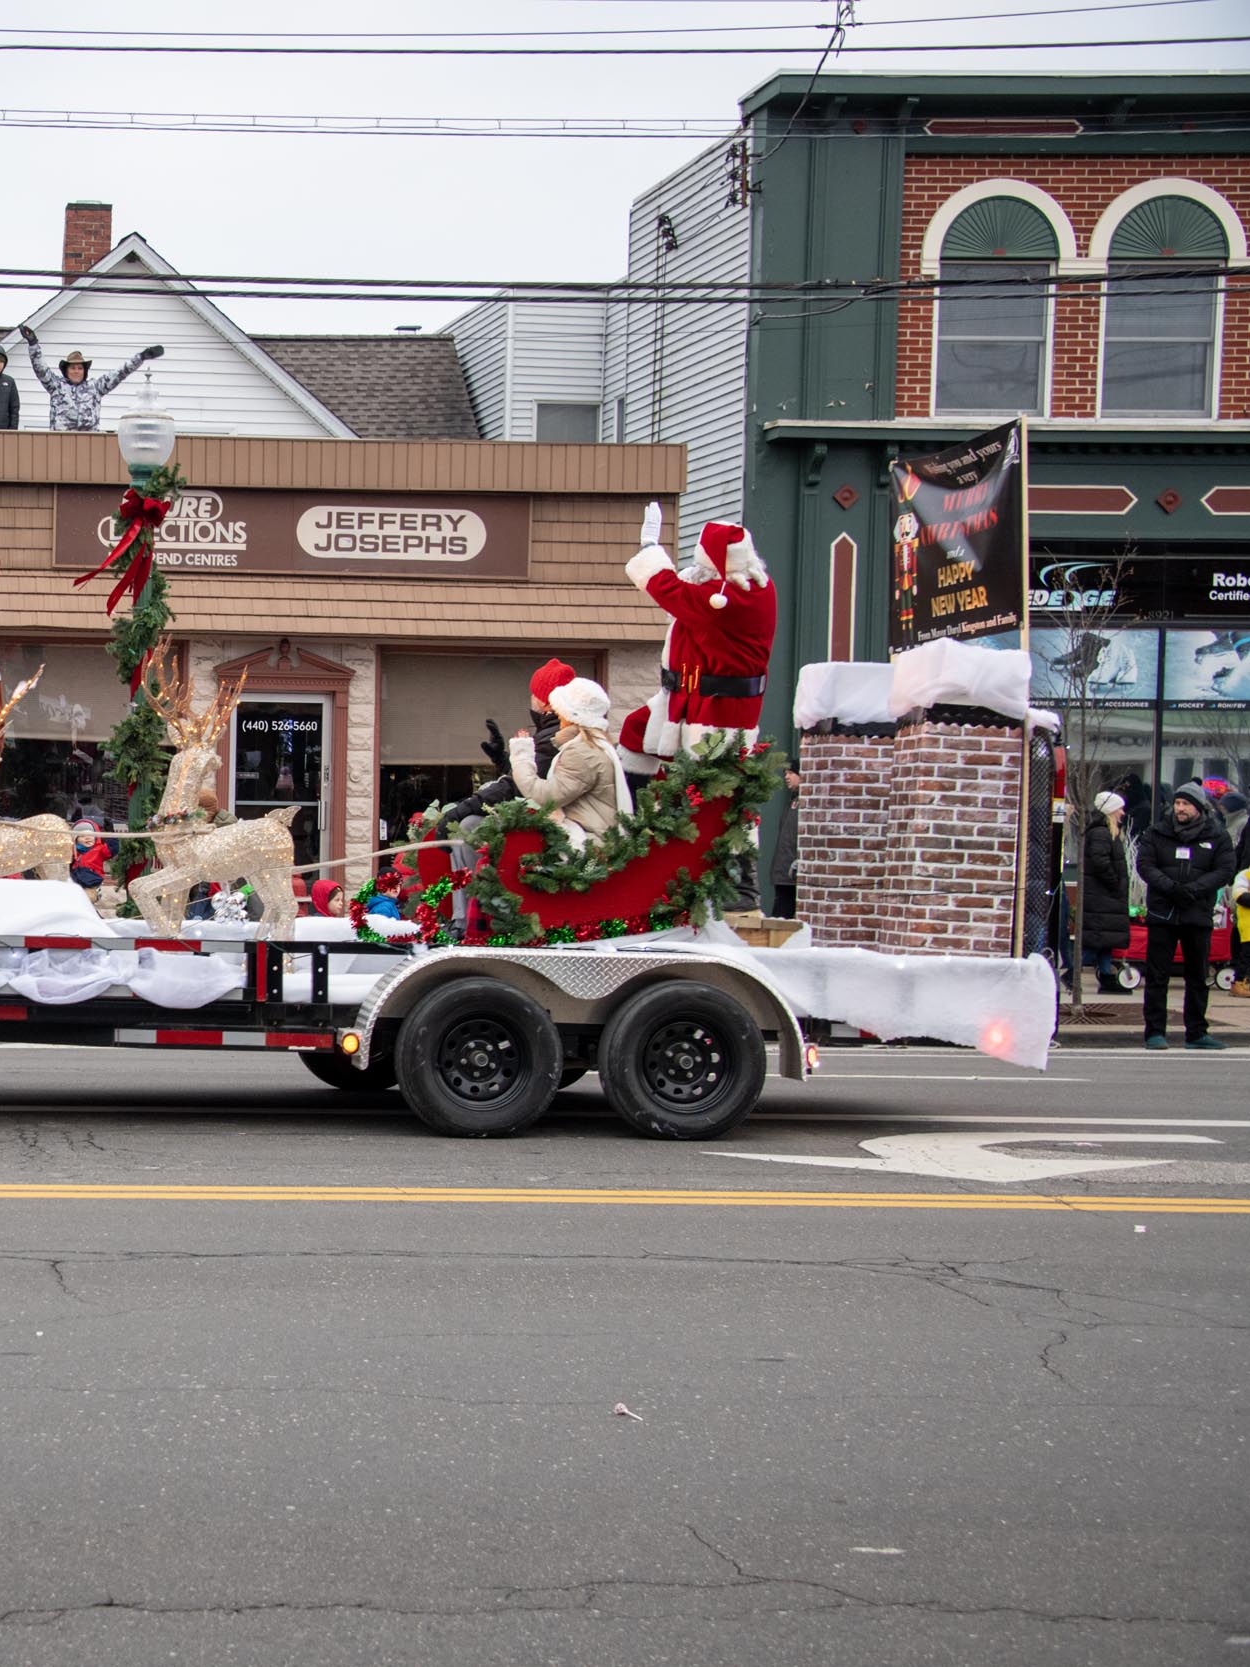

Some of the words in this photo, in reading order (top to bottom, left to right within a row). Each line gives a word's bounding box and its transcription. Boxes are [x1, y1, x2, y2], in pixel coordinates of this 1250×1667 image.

[976, 441, 1003, 462] yours
[315, 511, 467, 532] JEFFERY
[314, 533, 468, 555] JOSEPHS
[185, 553, 238, 566] CENTRES
[937, 560, 975, 588] HAPPY
[1212, 573, 1250, 587] Rob
[931, 593, 956, 618] NEW
[957, 585, 989, 612] YEAR
[241, 719, 269, 732] (440)
